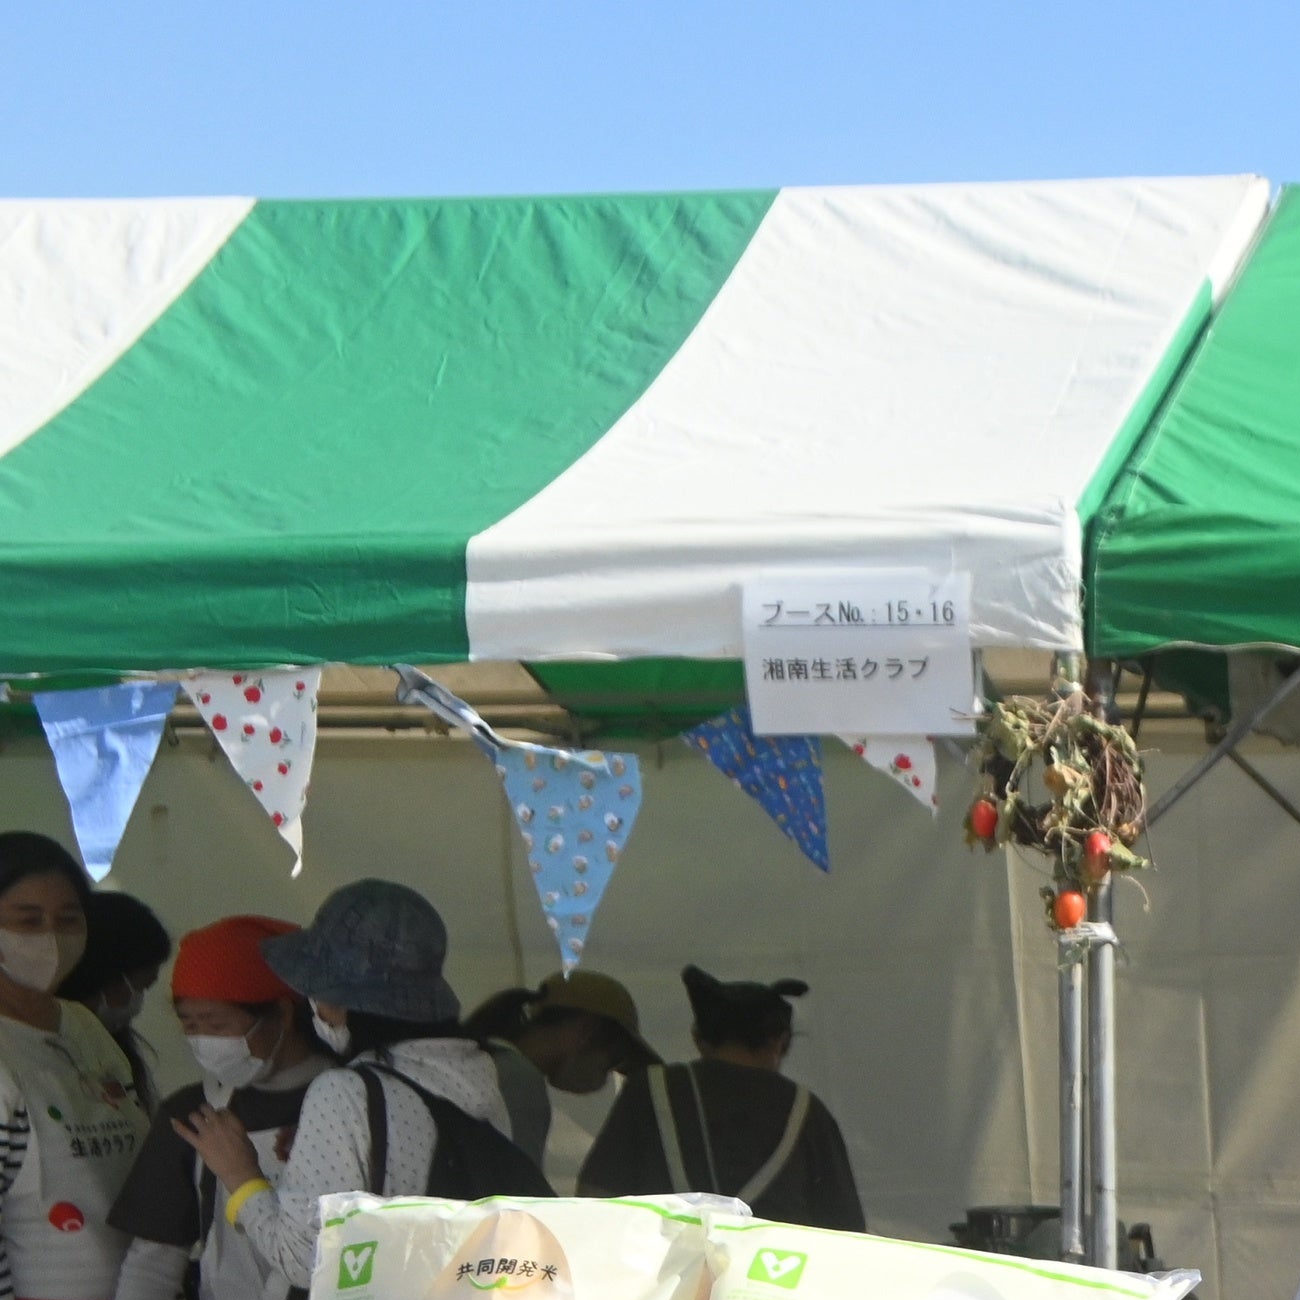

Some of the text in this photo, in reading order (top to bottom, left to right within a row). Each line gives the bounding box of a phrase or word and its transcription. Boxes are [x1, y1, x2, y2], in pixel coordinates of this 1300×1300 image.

[762, 655, 929, 681] 湘南生活クラブ
[457, 1258, 557, 1281] 共同開発米
